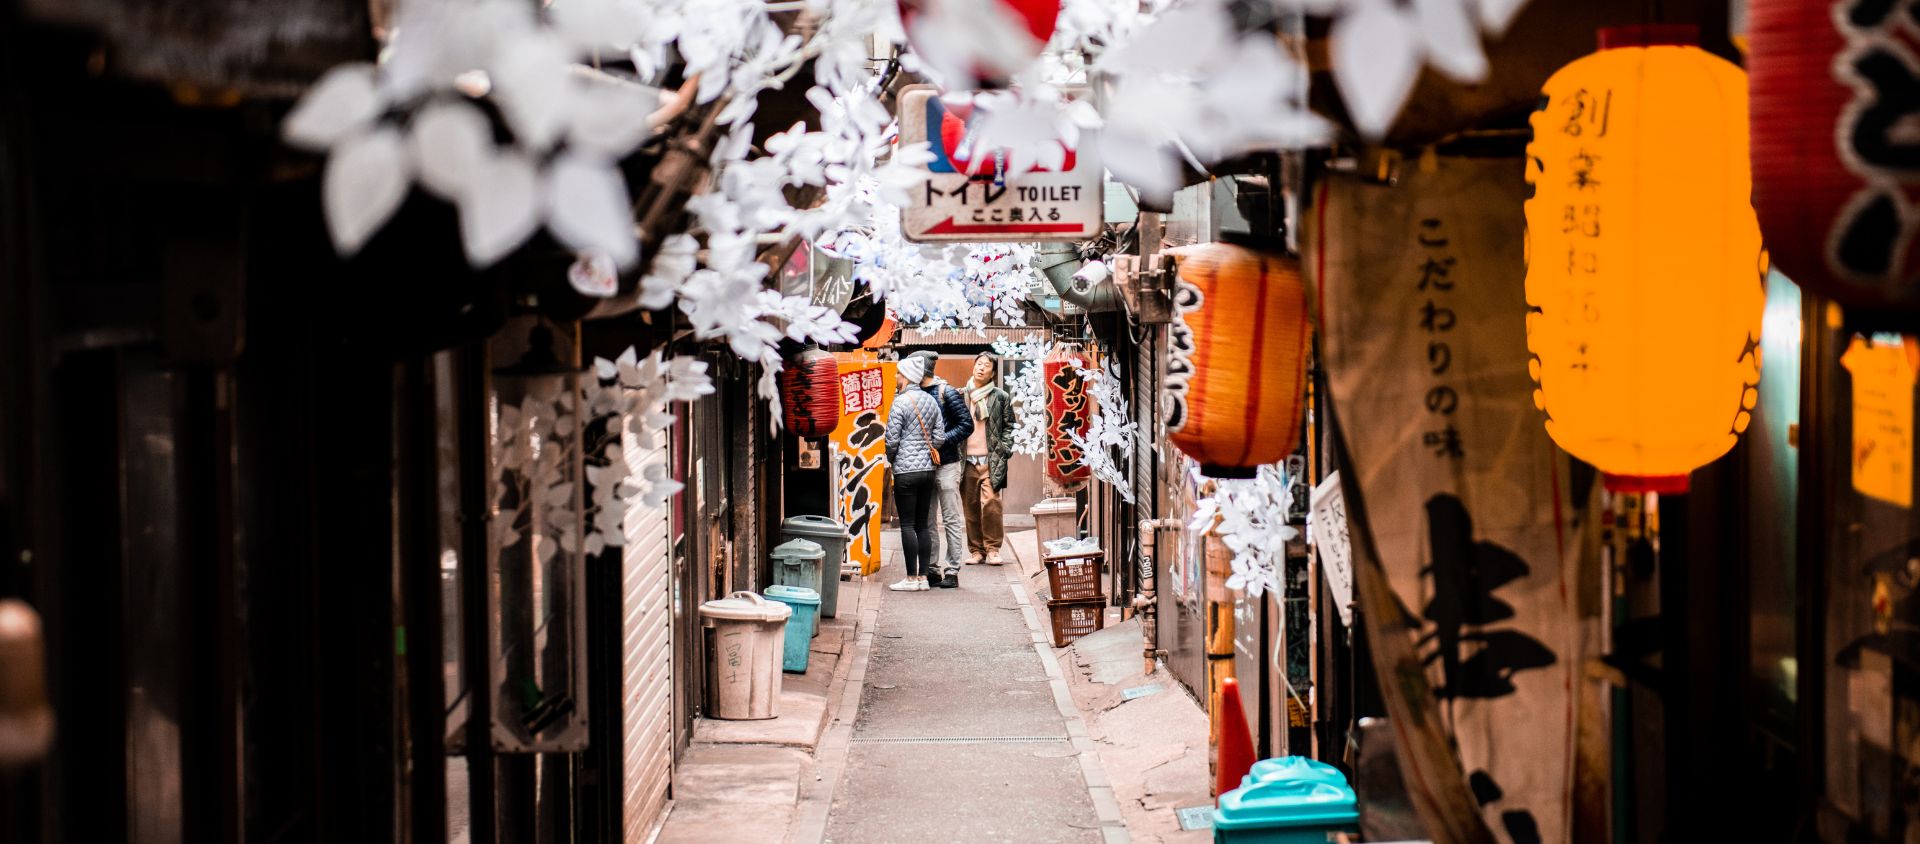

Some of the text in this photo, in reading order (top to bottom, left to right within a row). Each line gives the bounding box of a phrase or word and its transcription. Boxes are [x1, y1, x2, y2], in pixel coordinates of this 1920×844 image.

[926, 178, 1006, 206] トイレ
[1017, 185, 1082, 201] TOILET
[972, 207, 1060, 223] ここ奥入る
[1417, 218, 1464, 460] こだわりの味
[841, 372, 862, 414] 満足
[861, 368, 882, 410] 満腹
[849, 411, 886, 555] ランチ
